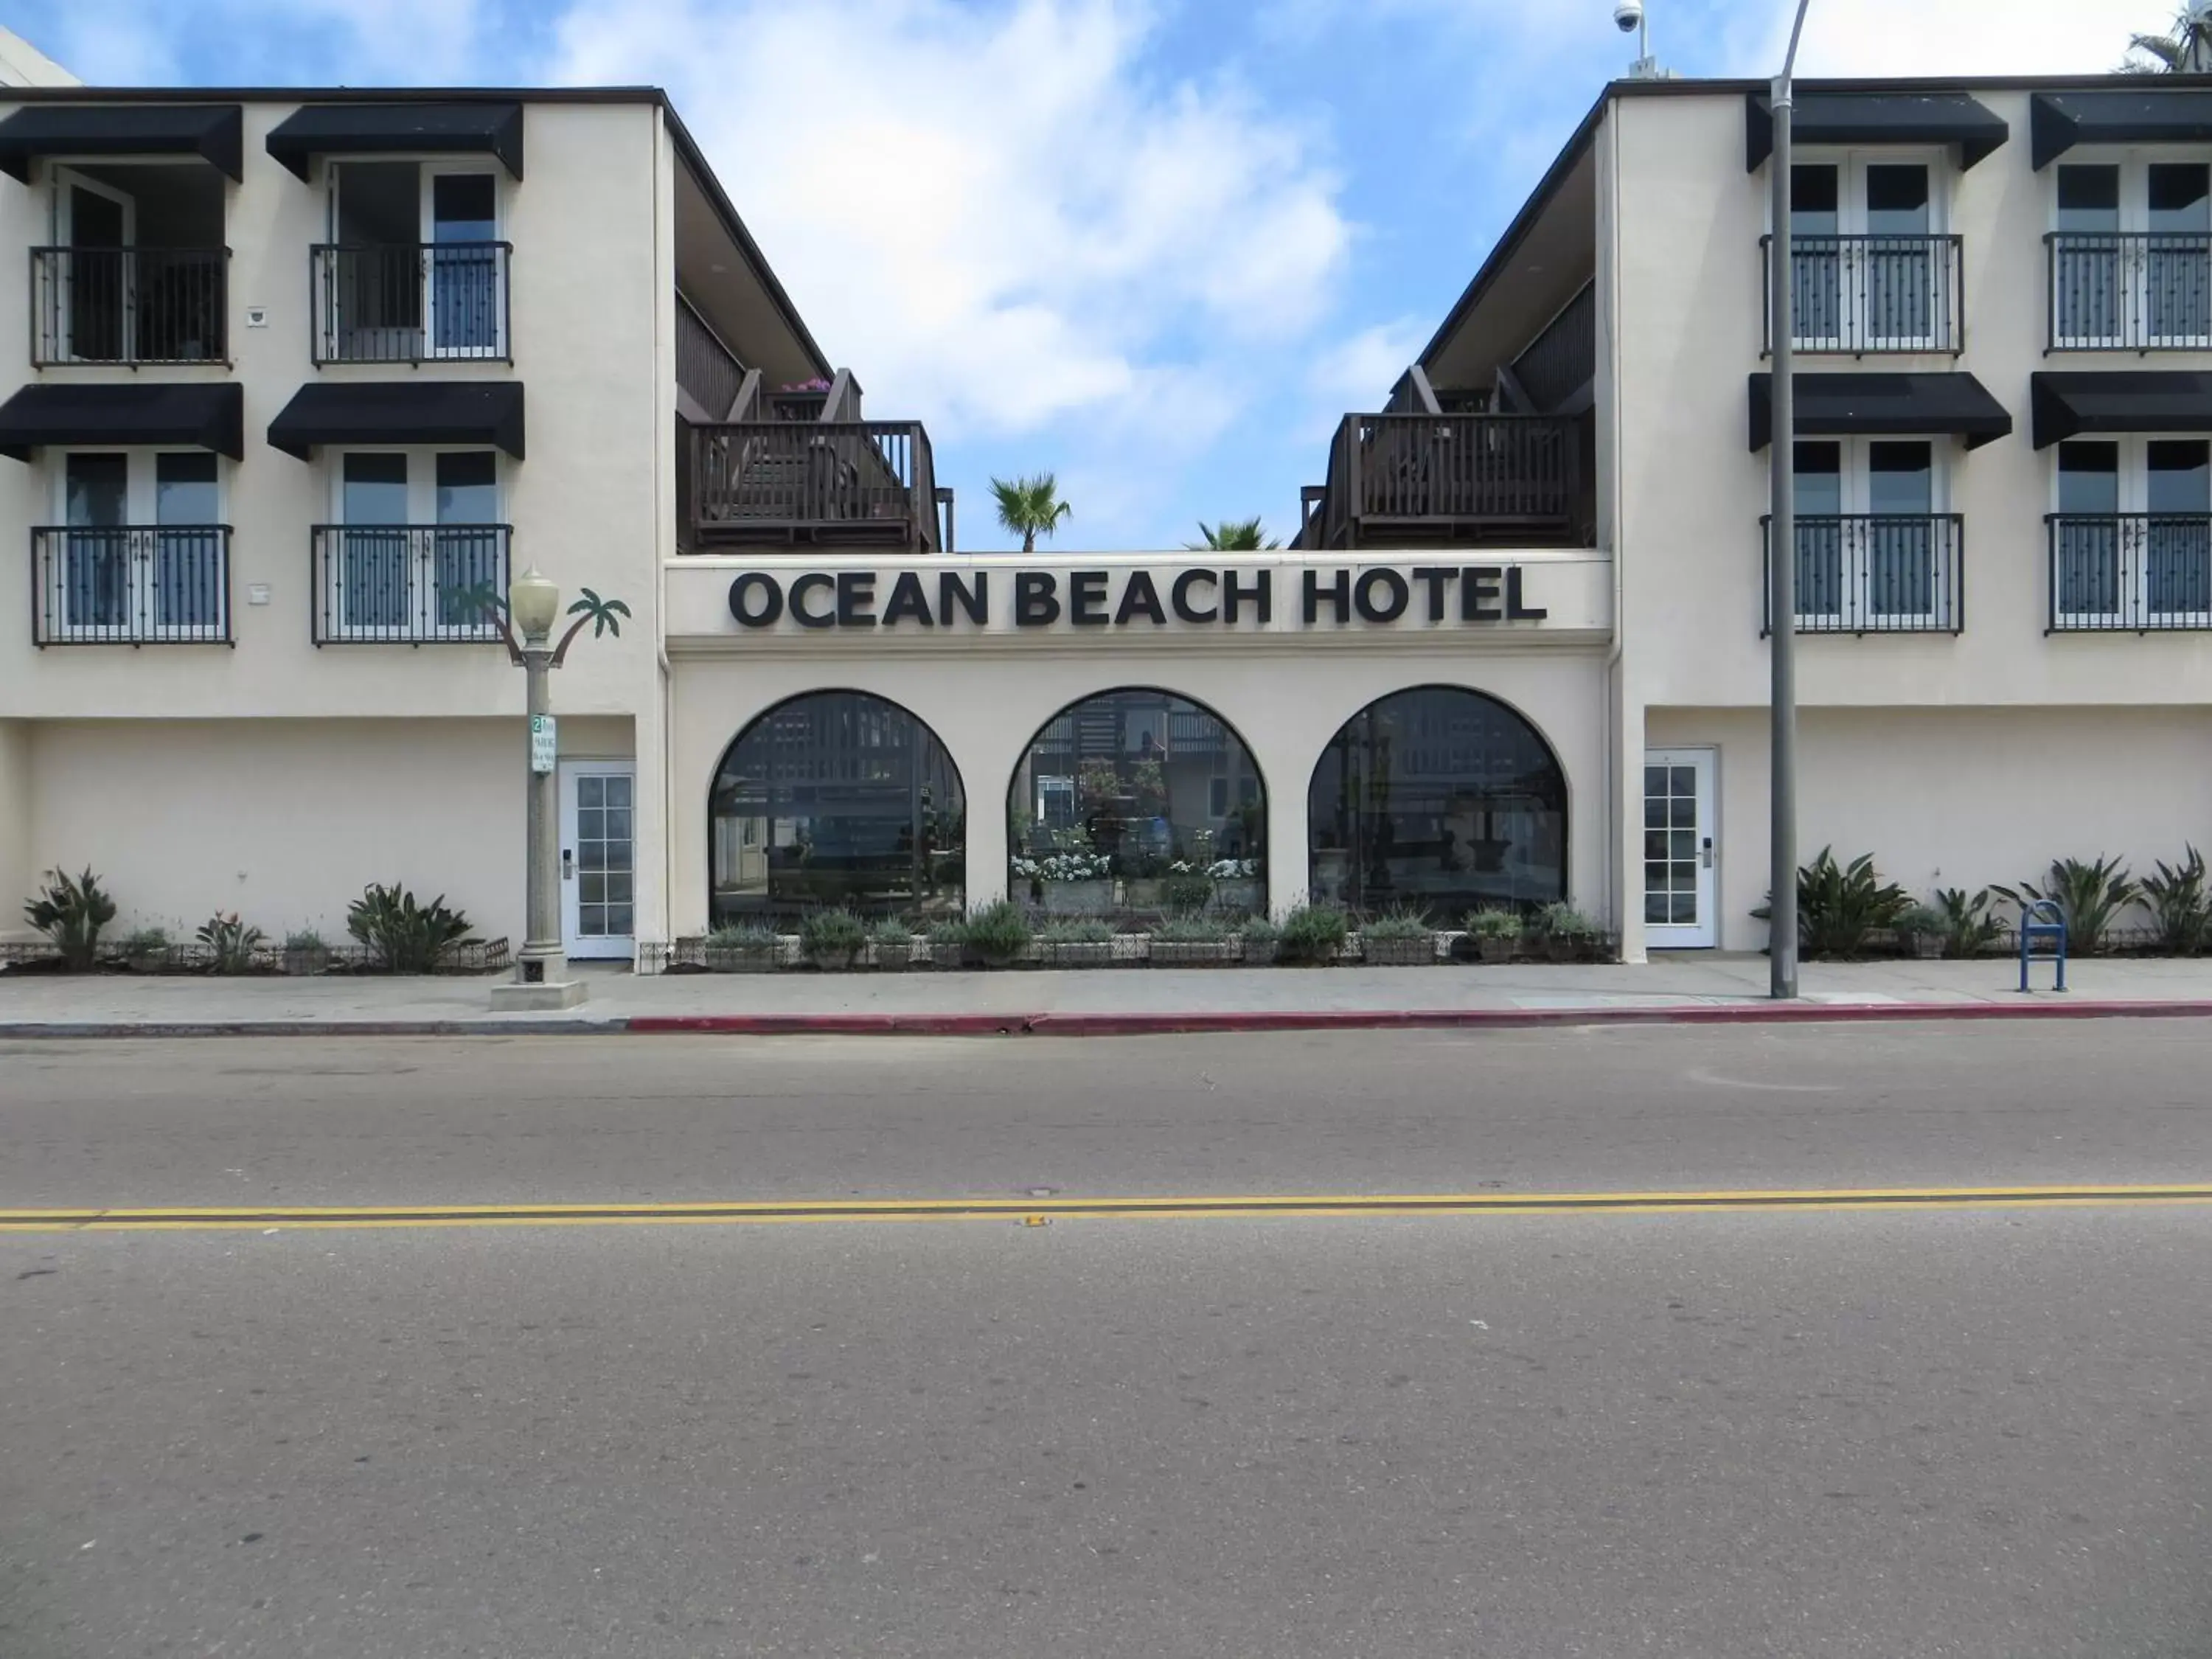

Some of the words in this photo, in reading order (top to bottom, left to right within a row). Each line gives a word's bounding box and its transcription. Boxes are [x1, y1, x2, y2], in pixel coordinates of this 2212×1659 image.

[728, 571, 989, 628] OCEAN
[1015, 568, 1272, 627] BEACH
[1302, 567, 1548, 623] HOTEL
[533, 717, 540, 731] 2
